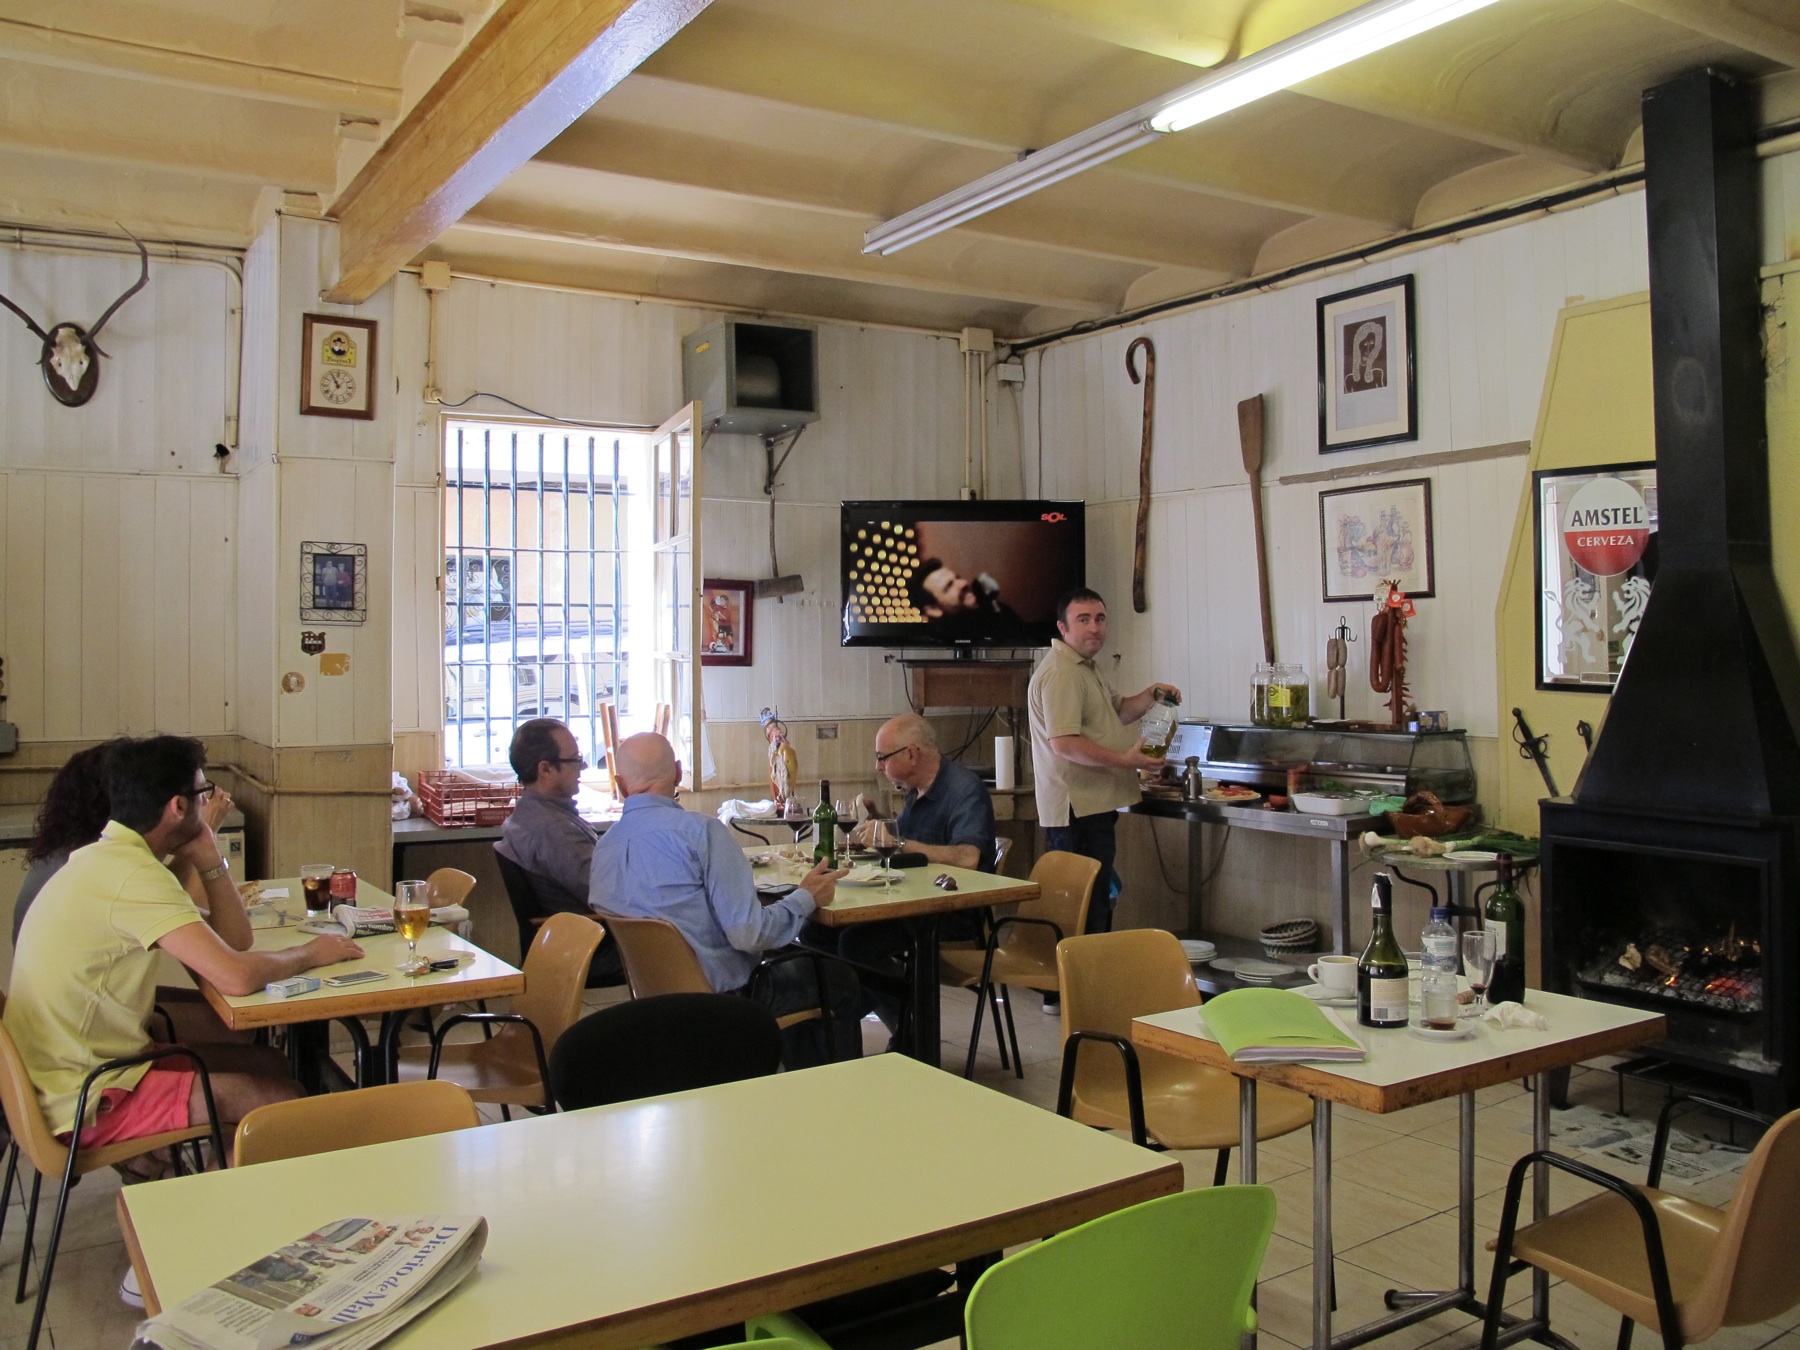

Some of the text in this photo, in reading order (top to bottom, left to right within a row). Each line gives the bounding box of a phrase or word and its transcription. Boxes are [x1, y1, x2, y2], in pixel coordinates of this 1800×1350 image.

[1571, 507, 1643, 527] AMSTEL
[1577, 535, 1635, 547] CERVEZA
[396, 1226, 460, 1277] Diario
[376, 1275, 399, 1292] de
